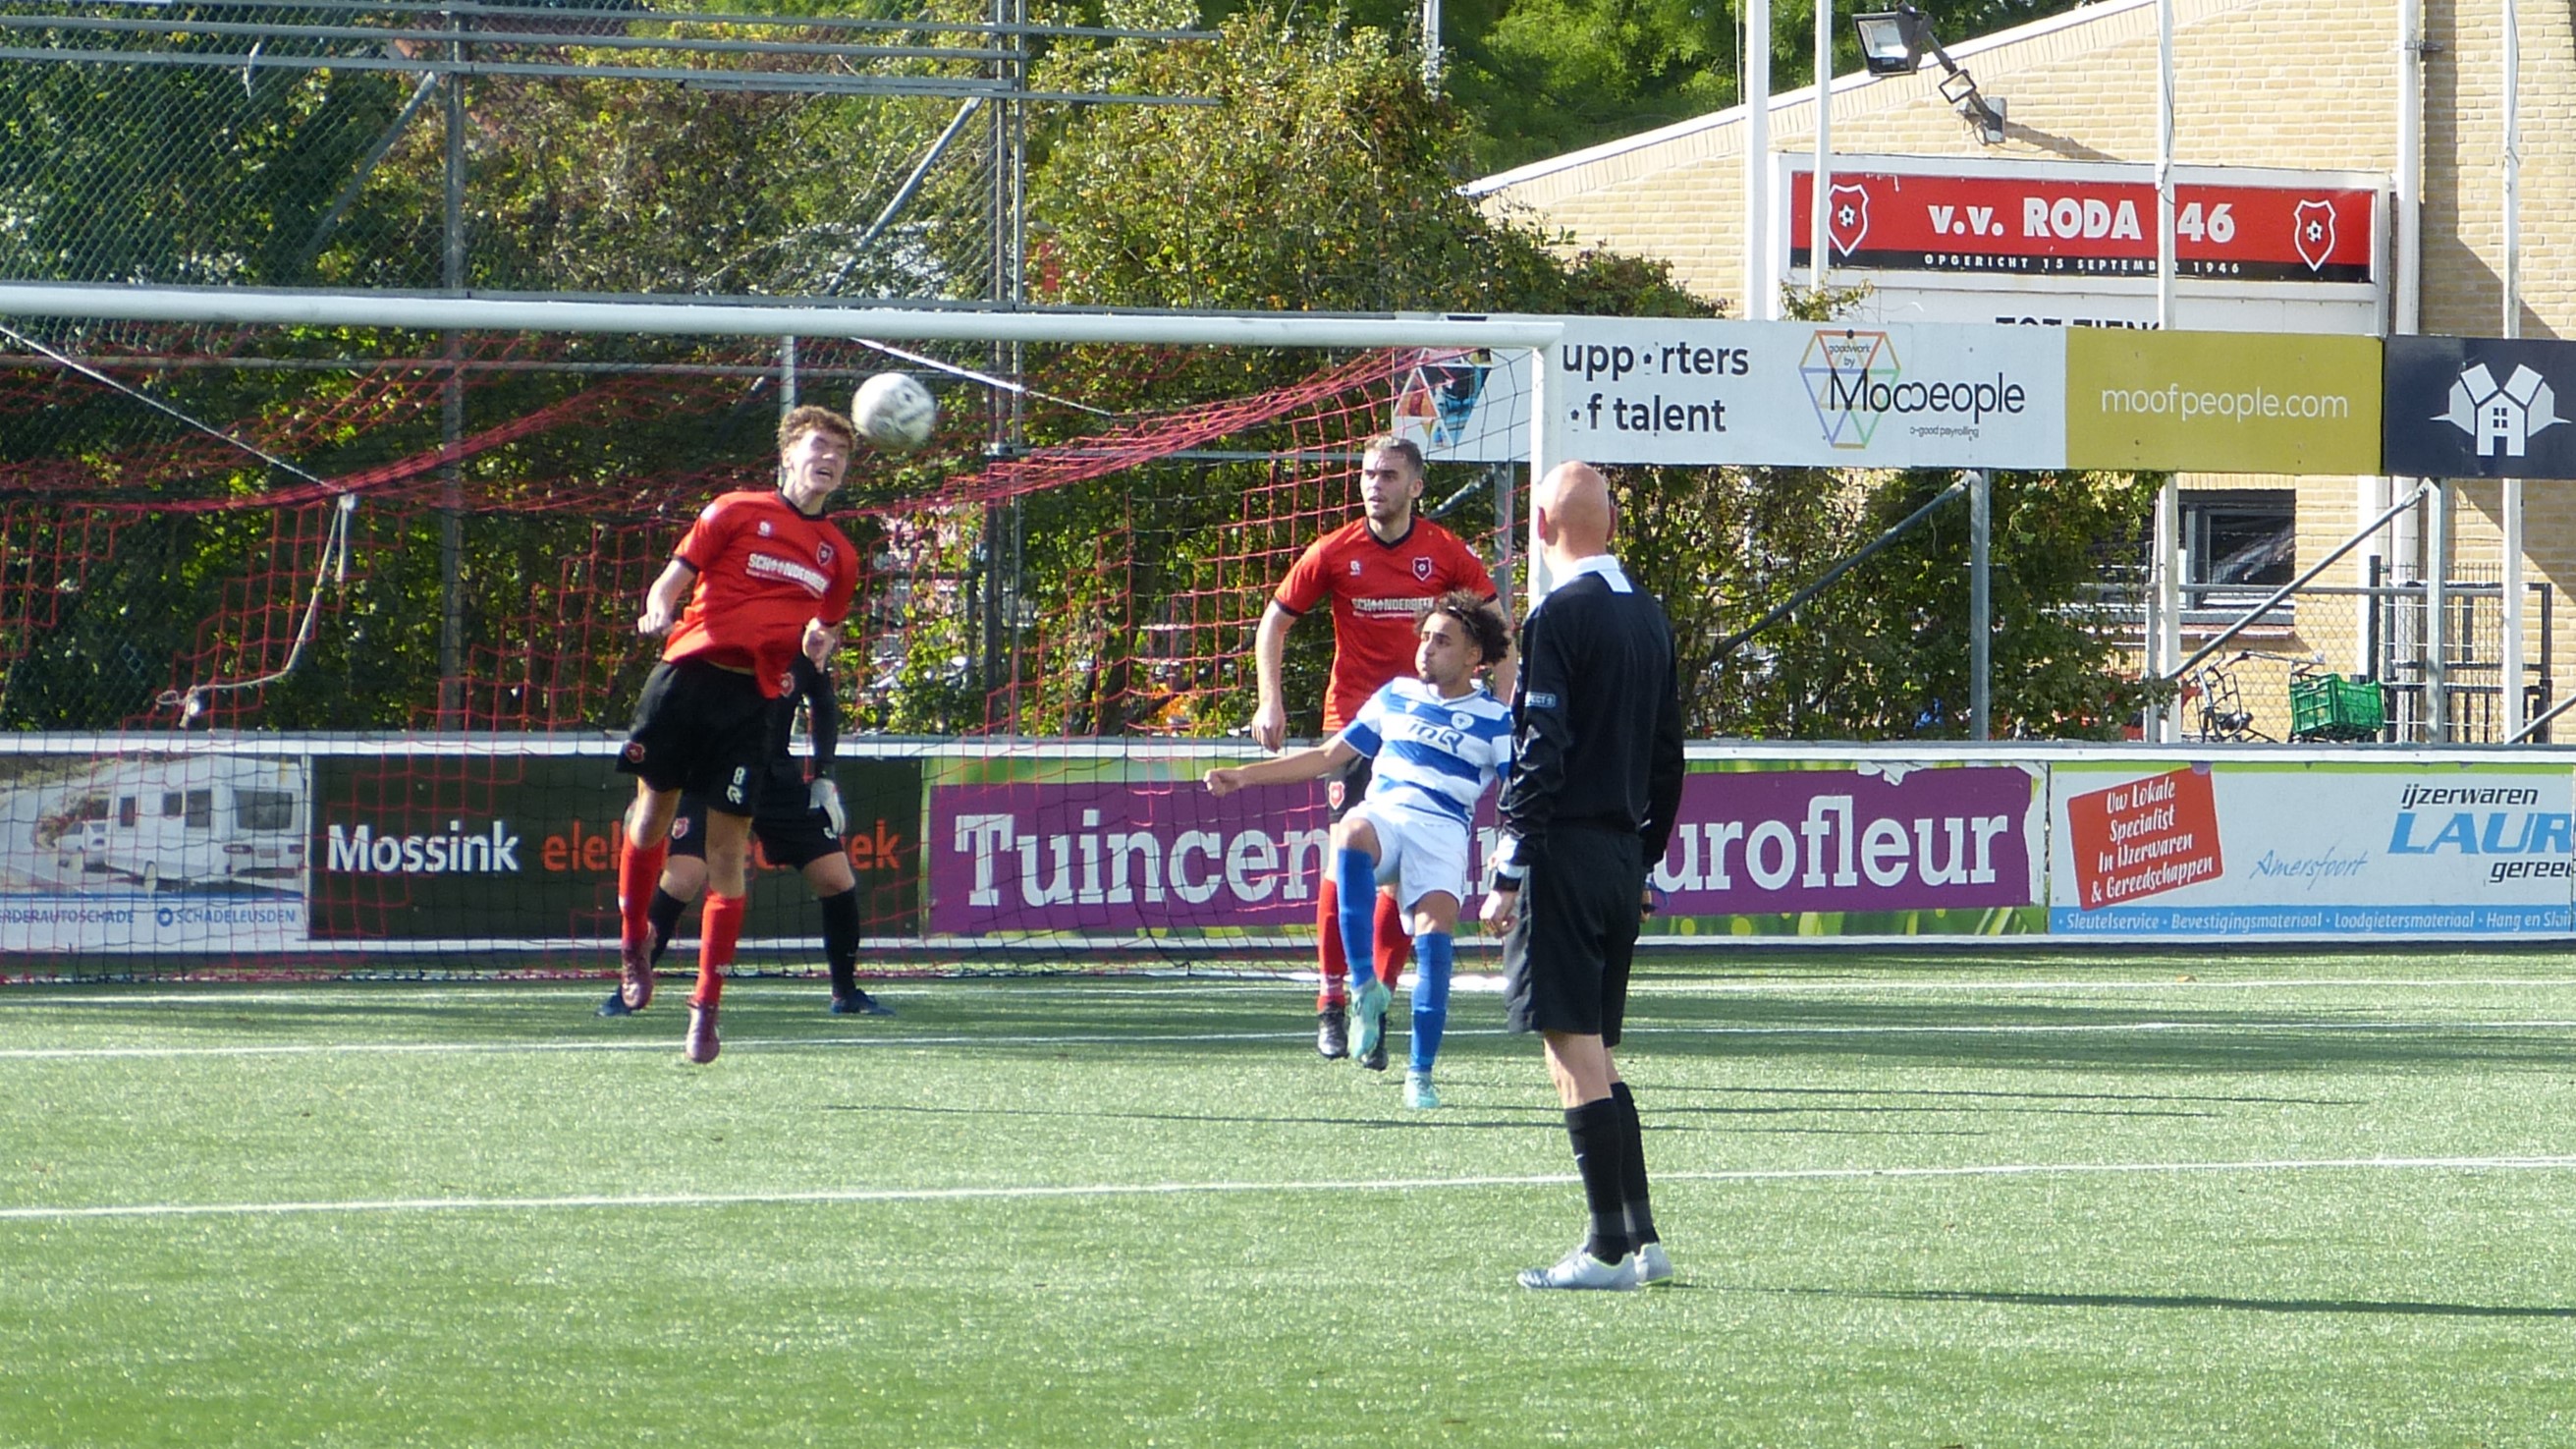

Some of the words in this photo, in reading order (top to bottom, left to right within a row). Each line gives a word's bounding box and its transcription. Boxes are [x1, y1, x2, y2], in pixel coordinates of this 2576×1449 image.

[1928, 205, 2004, 237] v.v.
[2023, 197, 2143, 241] RODA
[1924, 253, 2029, 270] OPGERICHT
[2043, 258, 2064, 271] 15
[2077, 259, 2180, 273] SEPTEMBR
[2193, 261, 2240, 275] 1946
[1613, 394, 1727, 433] talent
[2101, 383, 2348, 422] moofpeople.com
[2107, 791, 2128, 814] Uw
[2132, 775, 2176, 808] Lokale
[2401, 783, 2539, 809] ijzerwaren
[2110, 803, 2175, 845] Specialist
[327, 819, 520, 873] Mossink
[1652, 795, 2008, 893] urofleur
[2098, 851, 2113, 873] In
[2091, 880, 2103, 904] &
[2107, 856, 2214, 899] Gereedschappen
[2249, 845, 2369, 891] Amersfoort
[0, 909, 135, 924] RDERAUTOSCHADE
[177, 908, 296, 923] SCHADELEUSDEN
[2066, 913, 2160, 930] Sleutelservice
[2171, 912, 2323, 934] Bevestigingsmateriaal
[2334, 912, 2475, 932] Loodgietersmateriaal
[2486, 915, 2521, 932] Hang
[2524, 915, 2542, 927] en
